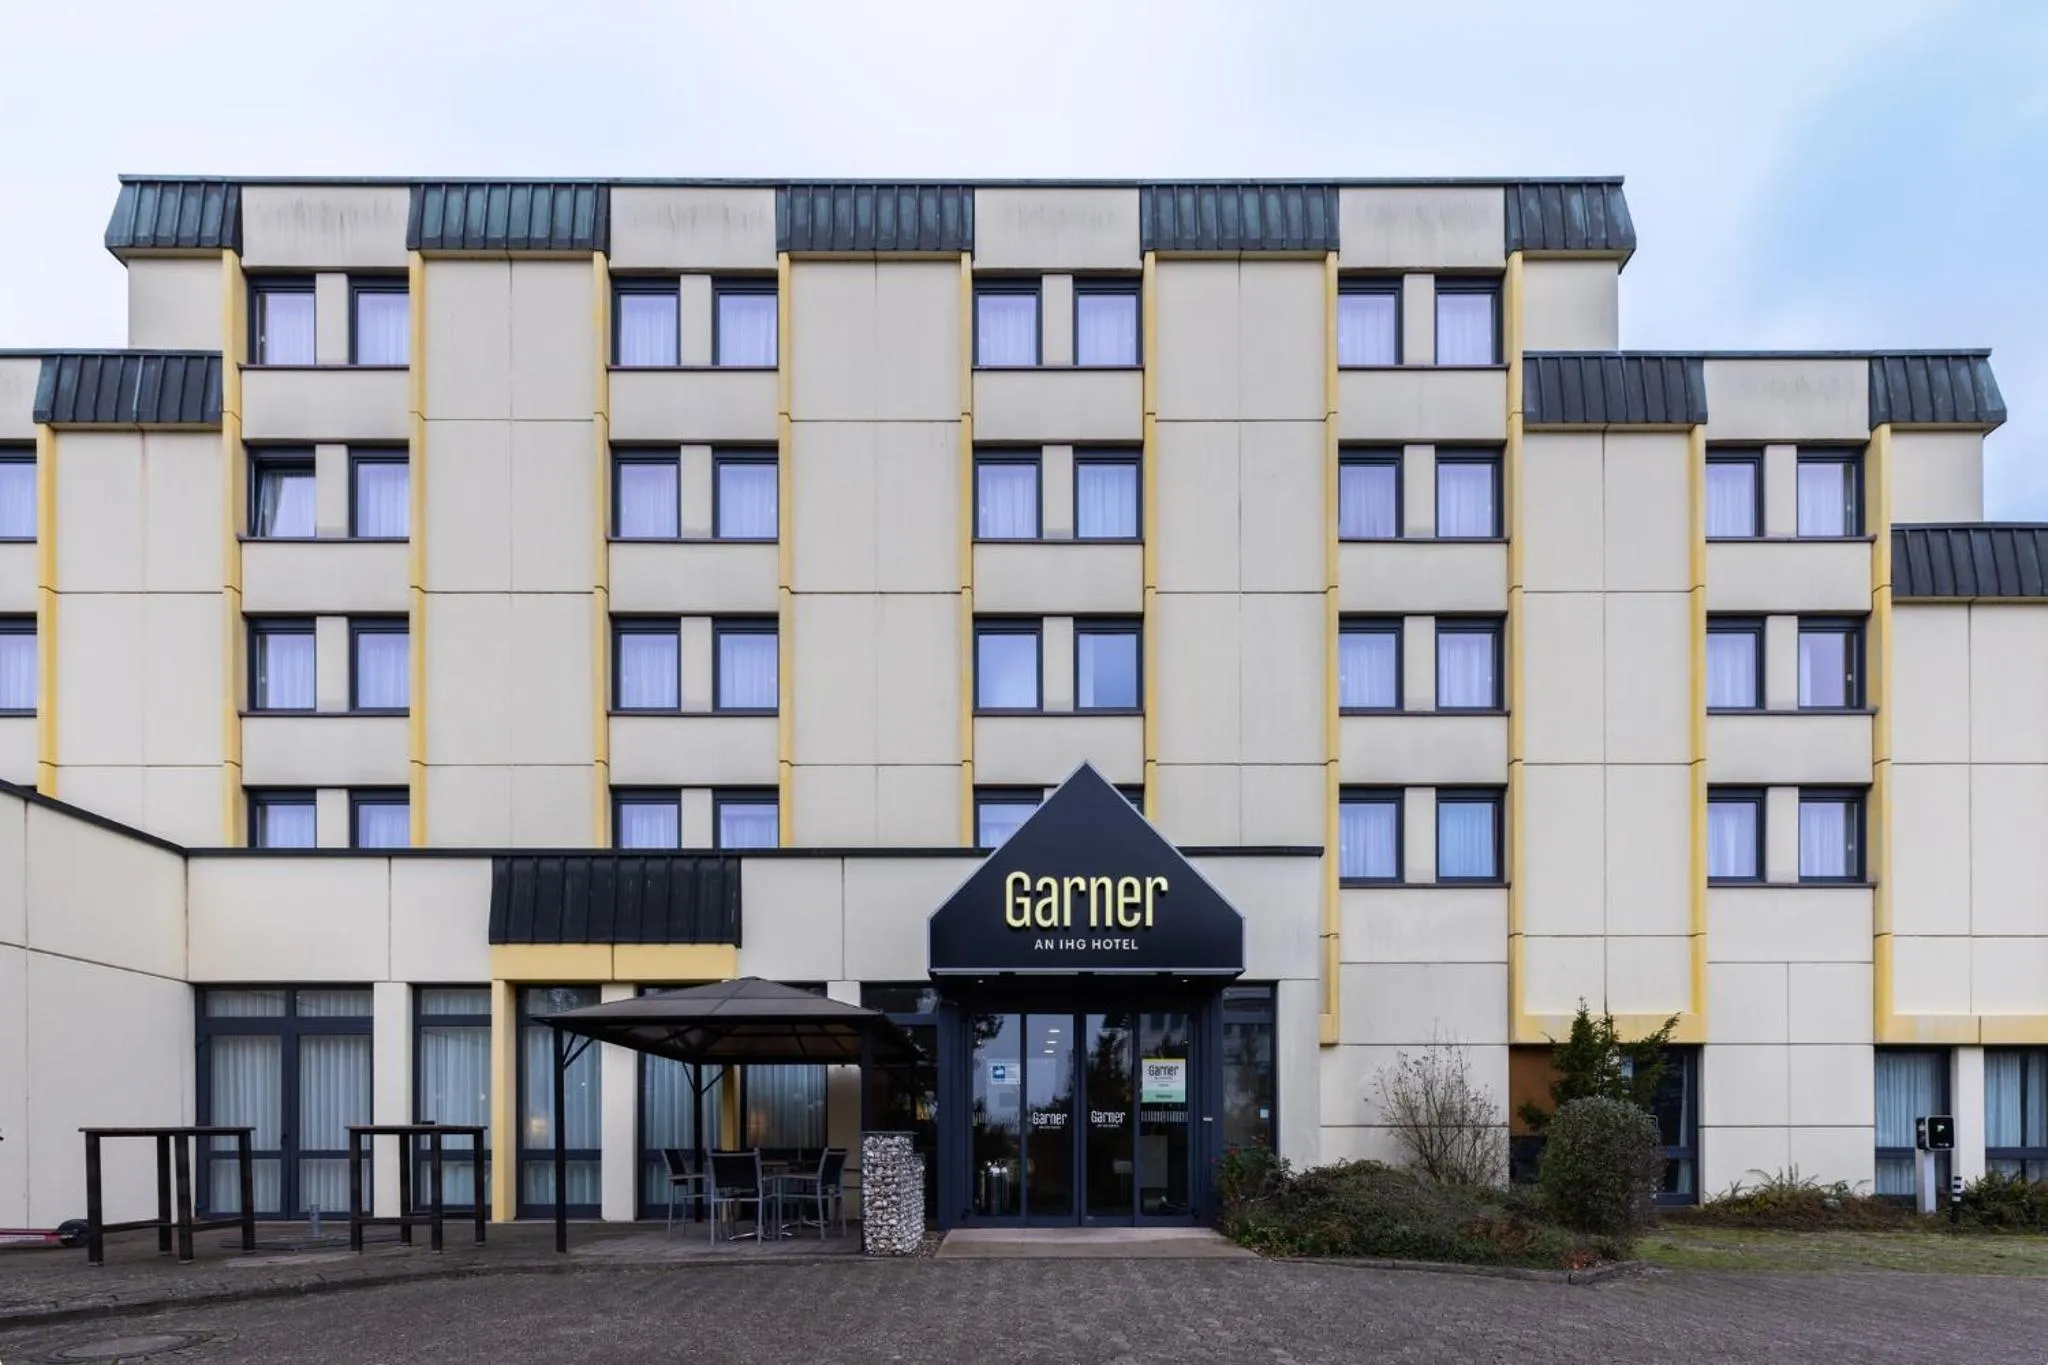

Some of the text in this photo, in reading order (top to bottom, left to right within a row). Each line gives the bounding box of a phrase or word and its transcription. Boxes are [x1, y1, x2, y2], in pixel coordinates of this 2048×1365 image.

[1005, 871, 1168, 928] Garner
[1034, 938, 1138, 950] AN IHG HOTEL
[1148, 1065, 1179, 1076] Garner
[1032, 1112, 1068, 1125] Garner
[1091, 1110, 1126, 1123] Garner
